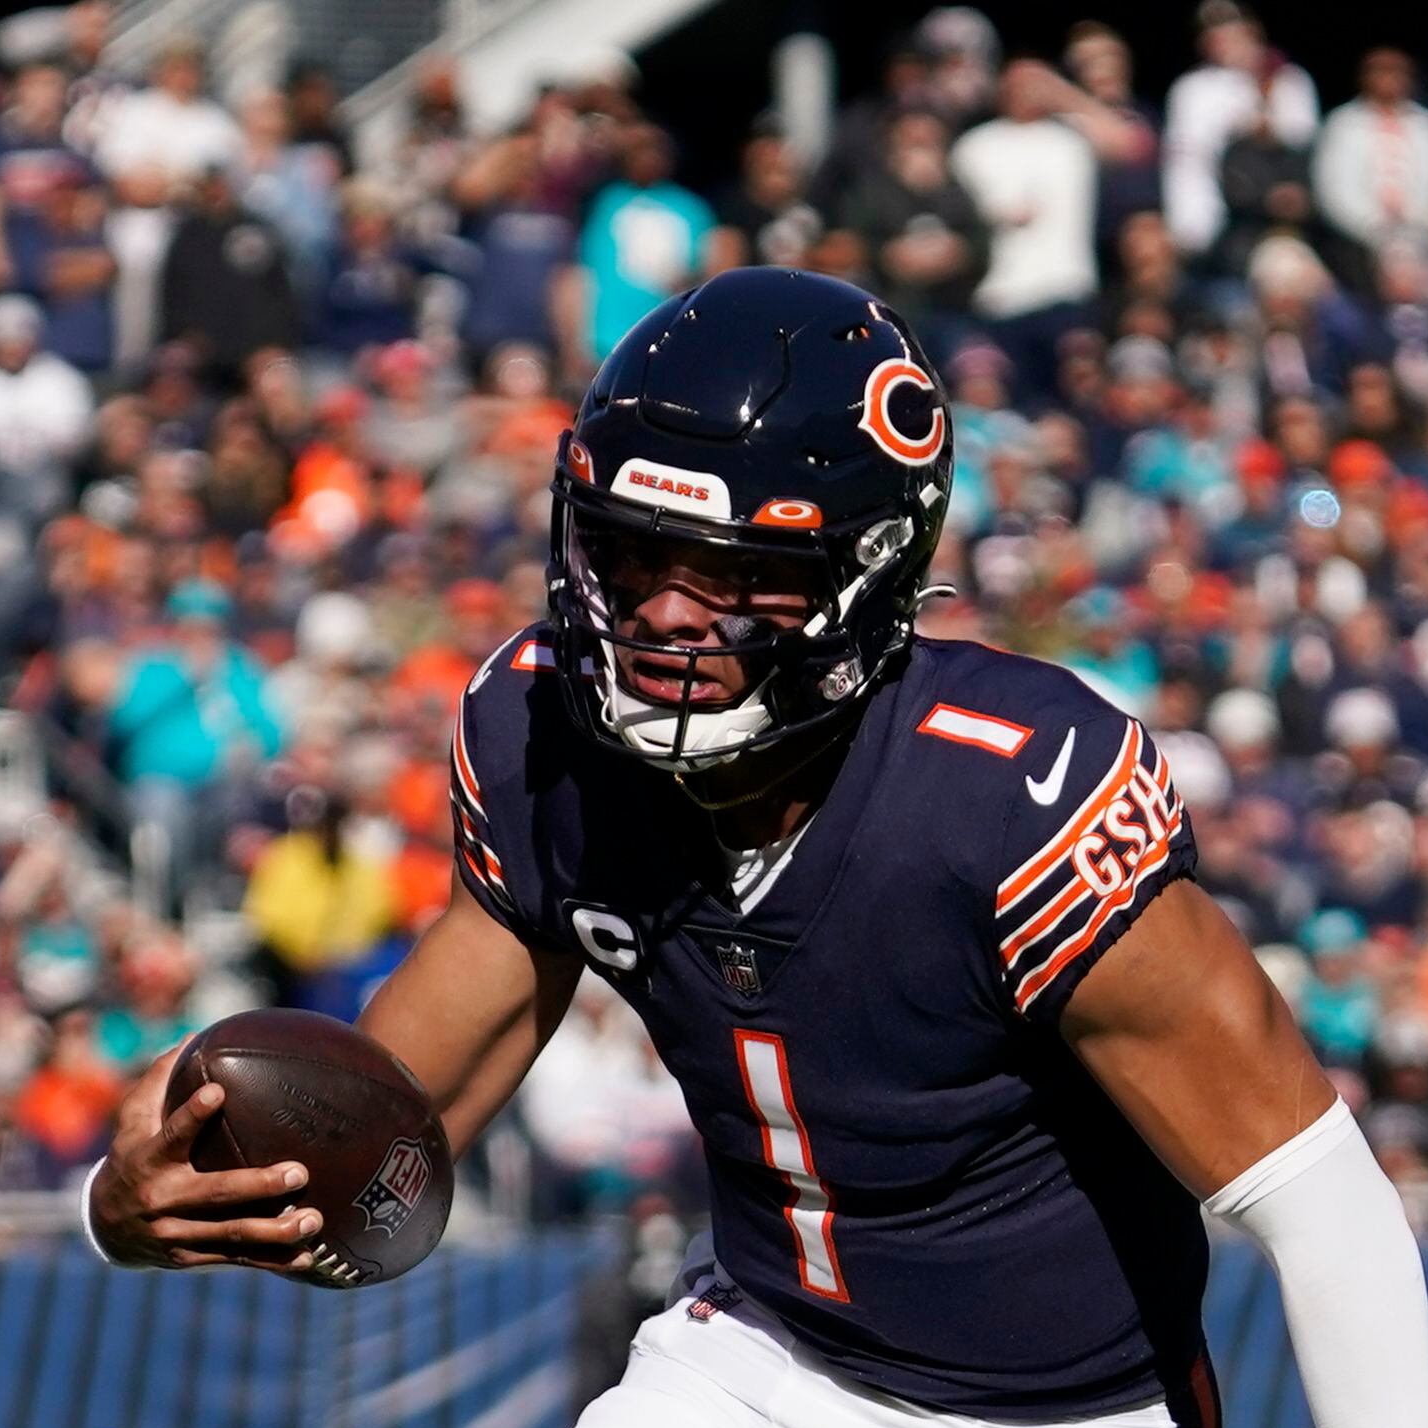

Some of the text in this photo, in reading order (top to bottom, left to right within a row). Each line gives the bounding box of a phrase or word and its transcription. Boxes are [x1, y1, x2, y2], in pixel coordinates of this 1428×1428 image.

[858, 358, 945, 467] C
[629, 470, 710, 501] BEARS
[916, 702, 1035, 760] 1
[1072, 762, 1170, 900] GSH
[572, 908, 637, 972] C
[386, 1147, 428, 1206] NFL
[733, 1029, 850, 1303] 1
